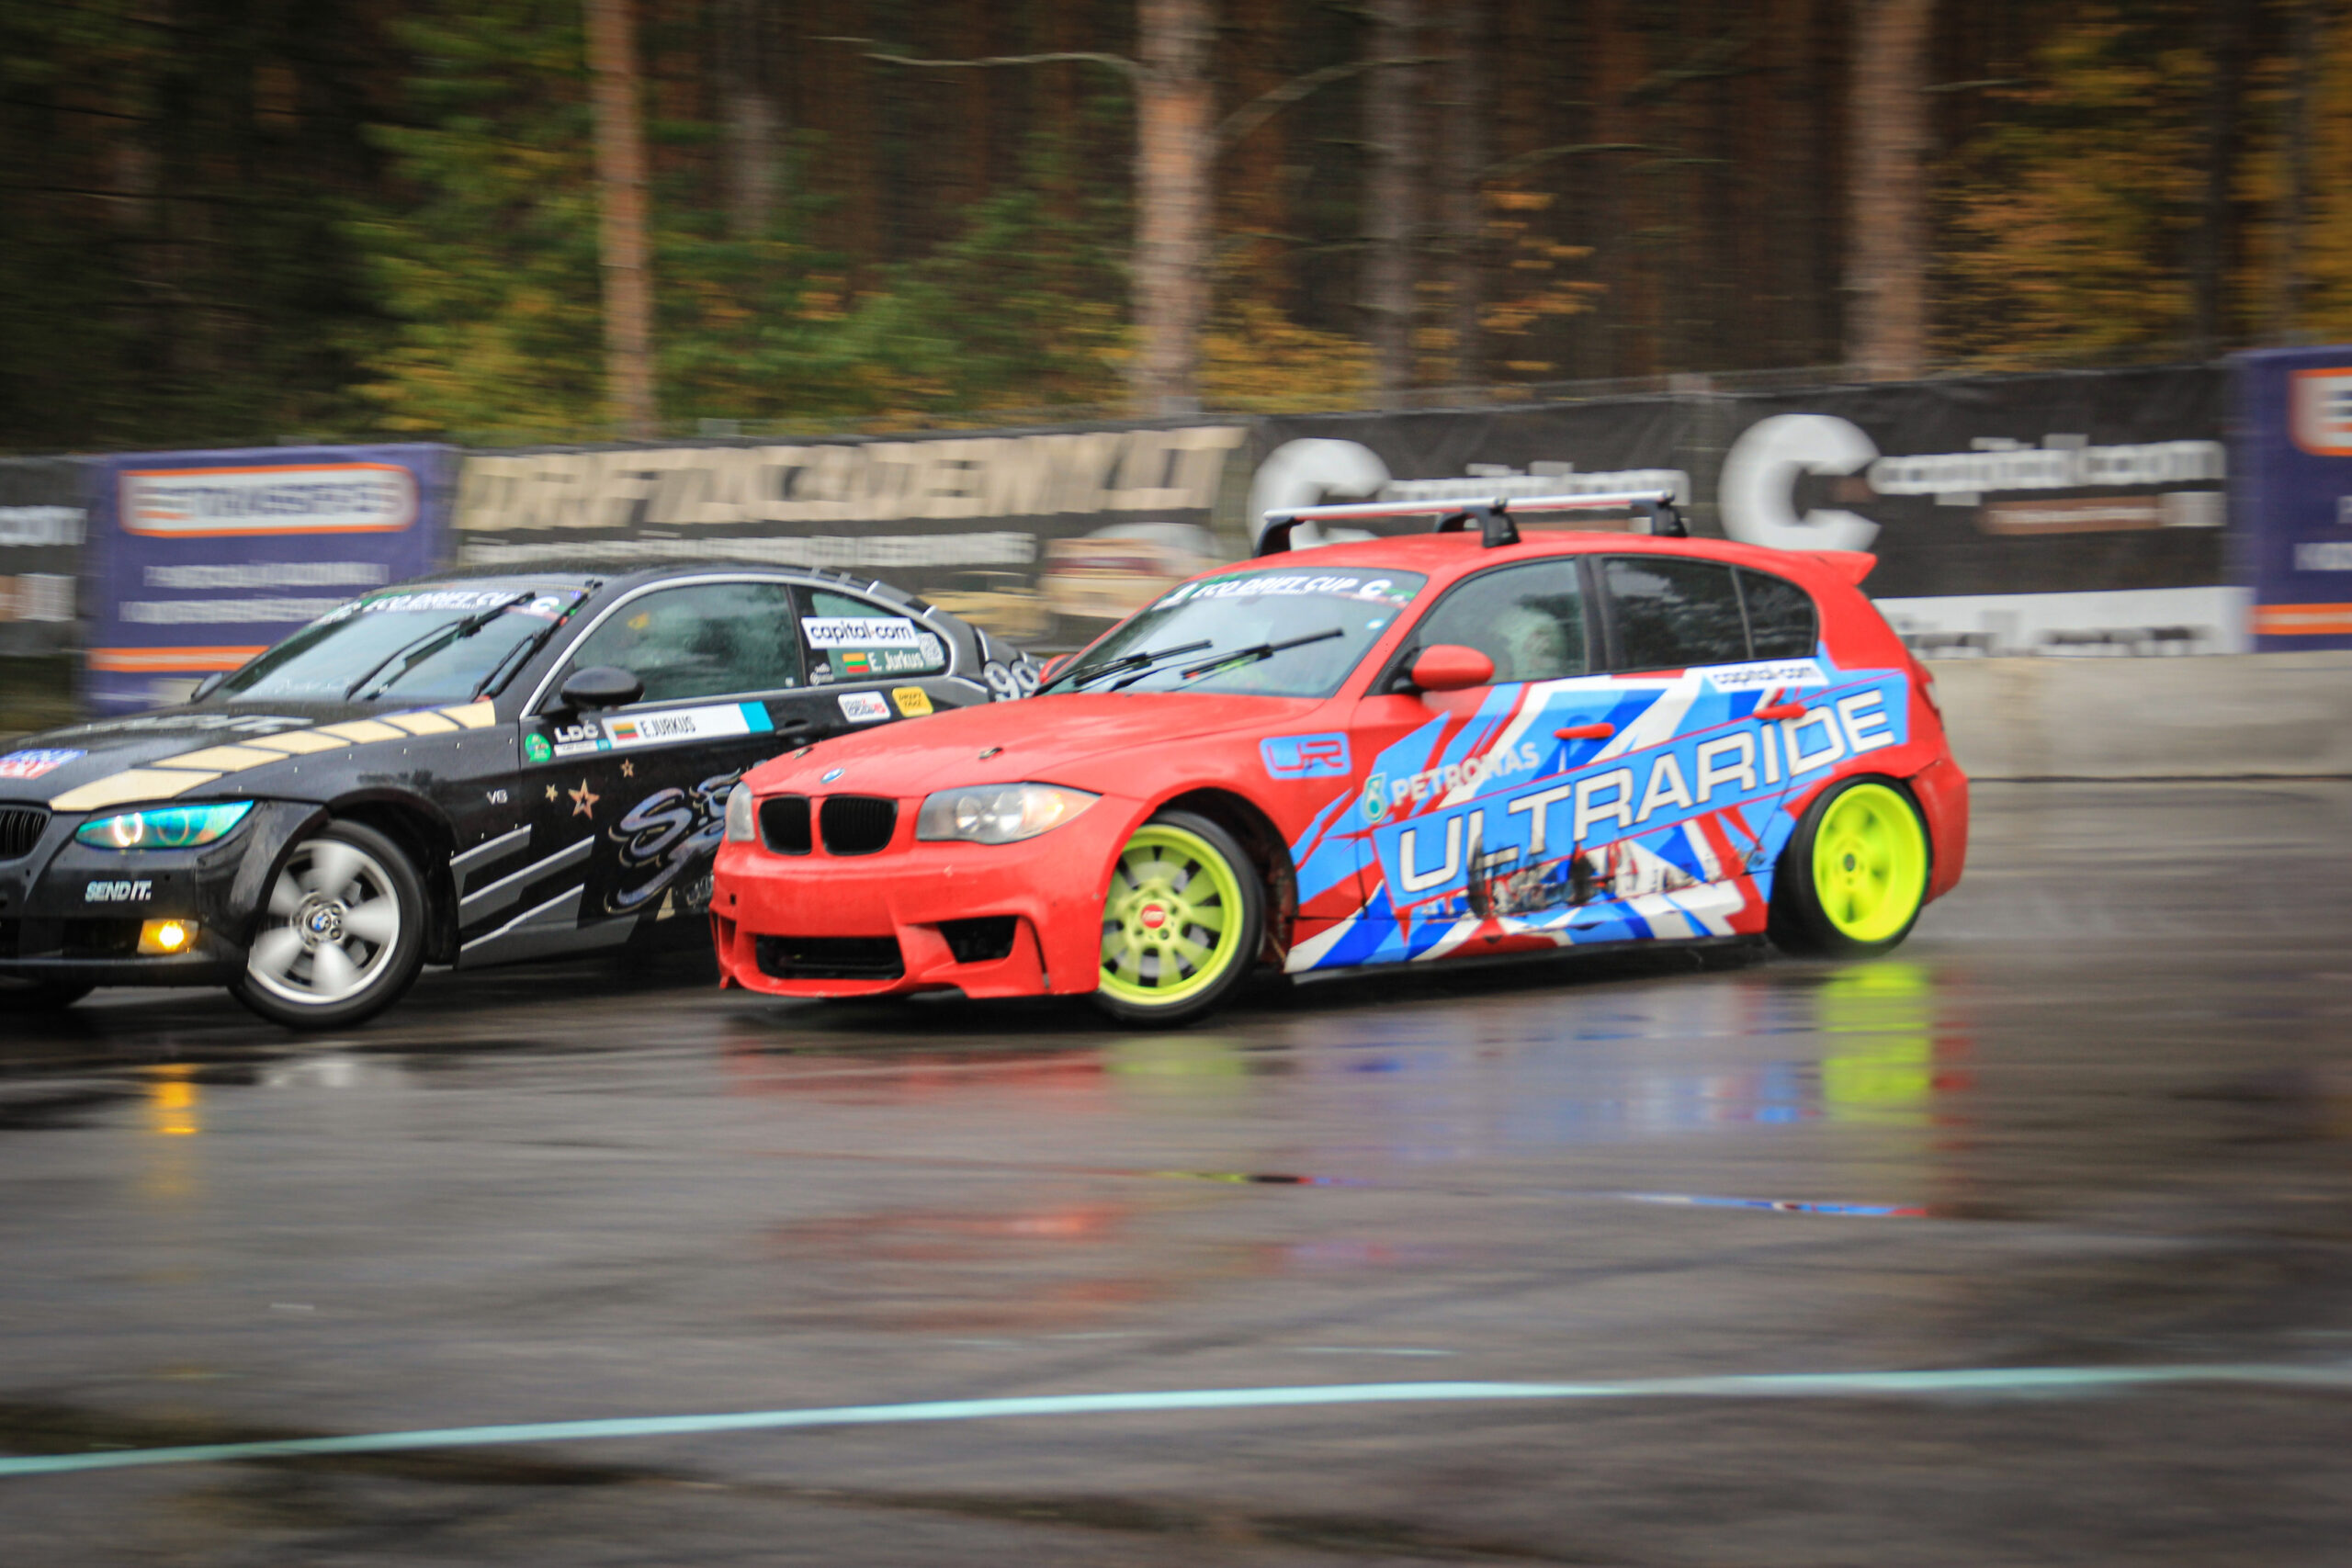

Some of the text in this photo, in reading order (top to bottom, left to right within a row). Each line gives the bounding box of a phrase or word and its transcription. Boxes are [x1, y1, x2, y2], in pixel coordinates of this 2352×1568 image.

[810, 621, 911, 644] capital.com
[867, 649, 924, 671] E. Jurkus
[1390, 742, 1540, 806] PETRONAS
[1399, 689, 1894, 894] ULTRARIDE
[85, 881, 131, 902] SEND
